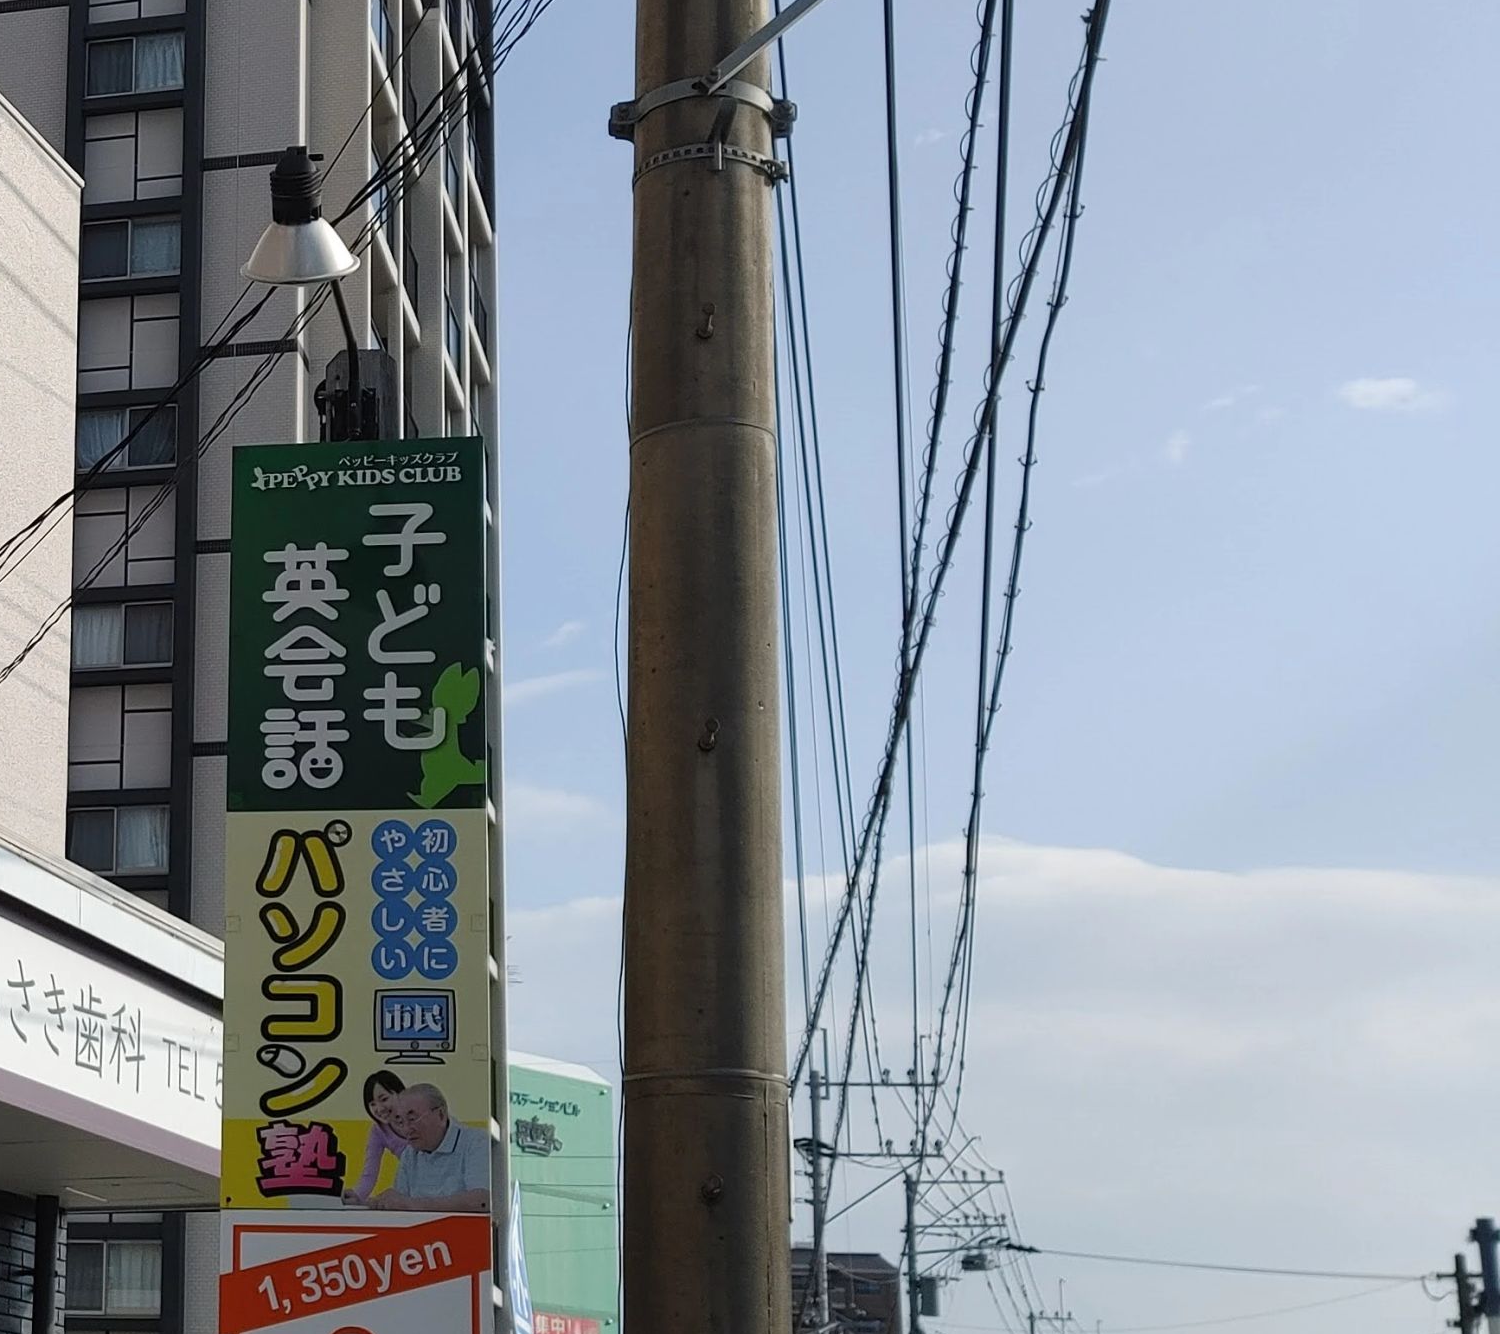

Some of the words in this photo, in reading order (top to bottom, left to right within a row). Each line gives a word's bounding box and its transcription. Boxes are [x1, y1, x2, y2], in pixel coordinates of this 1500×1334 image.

[265, 464, 334, 491] PEPPY
[337, 468, 396, 486] KIDS
[399, 466, 462, 484] CLUB
[338, 451, 459, 467] ペッピーキッズクラブ
[361, 502, 448, 751] 子ども
[259, 541, 350, 790] 英会話
[380, 828, 408, 971] やさしい
[420, 826, 451, 971] 初心者に
[384, 1002, 445, 1035] 市民
[162, 1037, 205, 1102] TEL
[510, 1091, 581, 1117] ステーションビル
